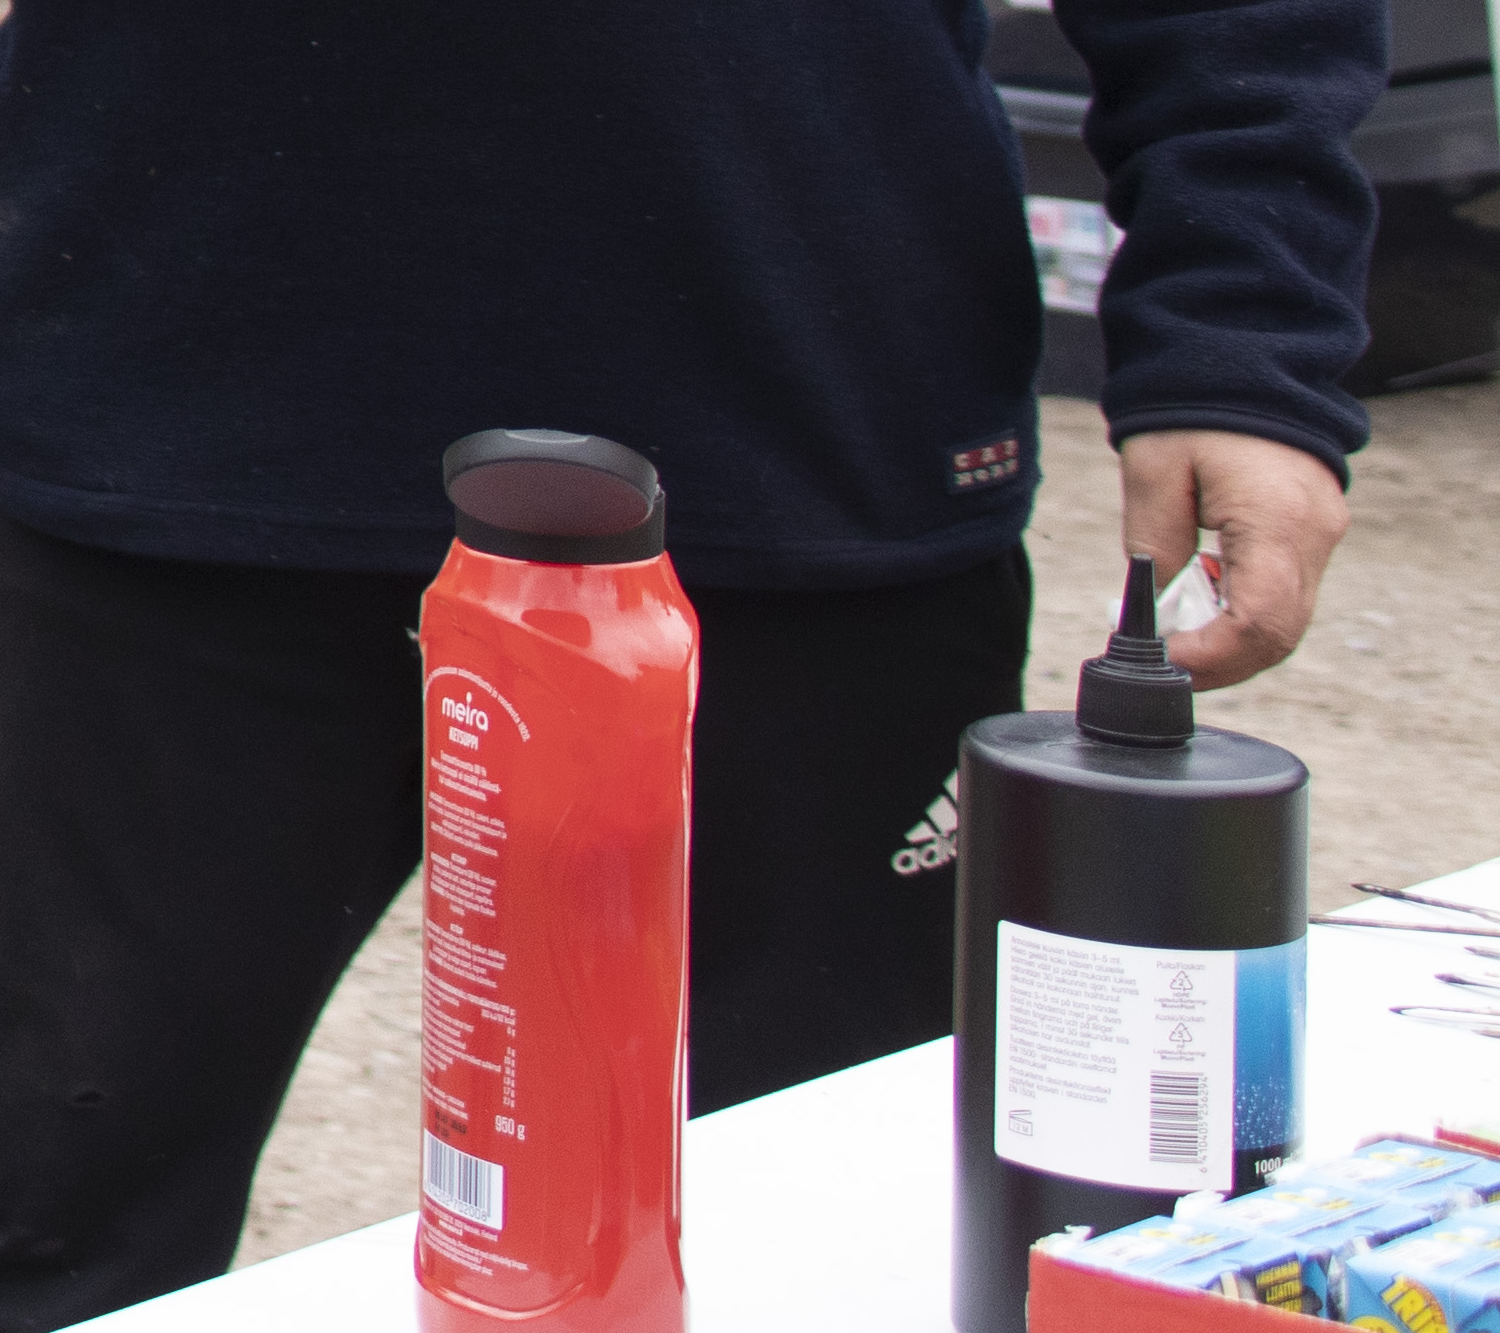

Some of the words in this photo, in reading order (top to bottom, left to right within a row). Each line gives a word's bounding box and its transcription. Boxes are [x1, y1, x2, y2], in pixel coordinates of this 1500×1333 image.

[441, 691, 489, 731] meira
[1198, 1076, 1209, 1116] 256294
[494, 1115, 514, 1135] 950
[516, 1123, 525, 1141] g
[1254, 1158, 1282, 1175] 1000
